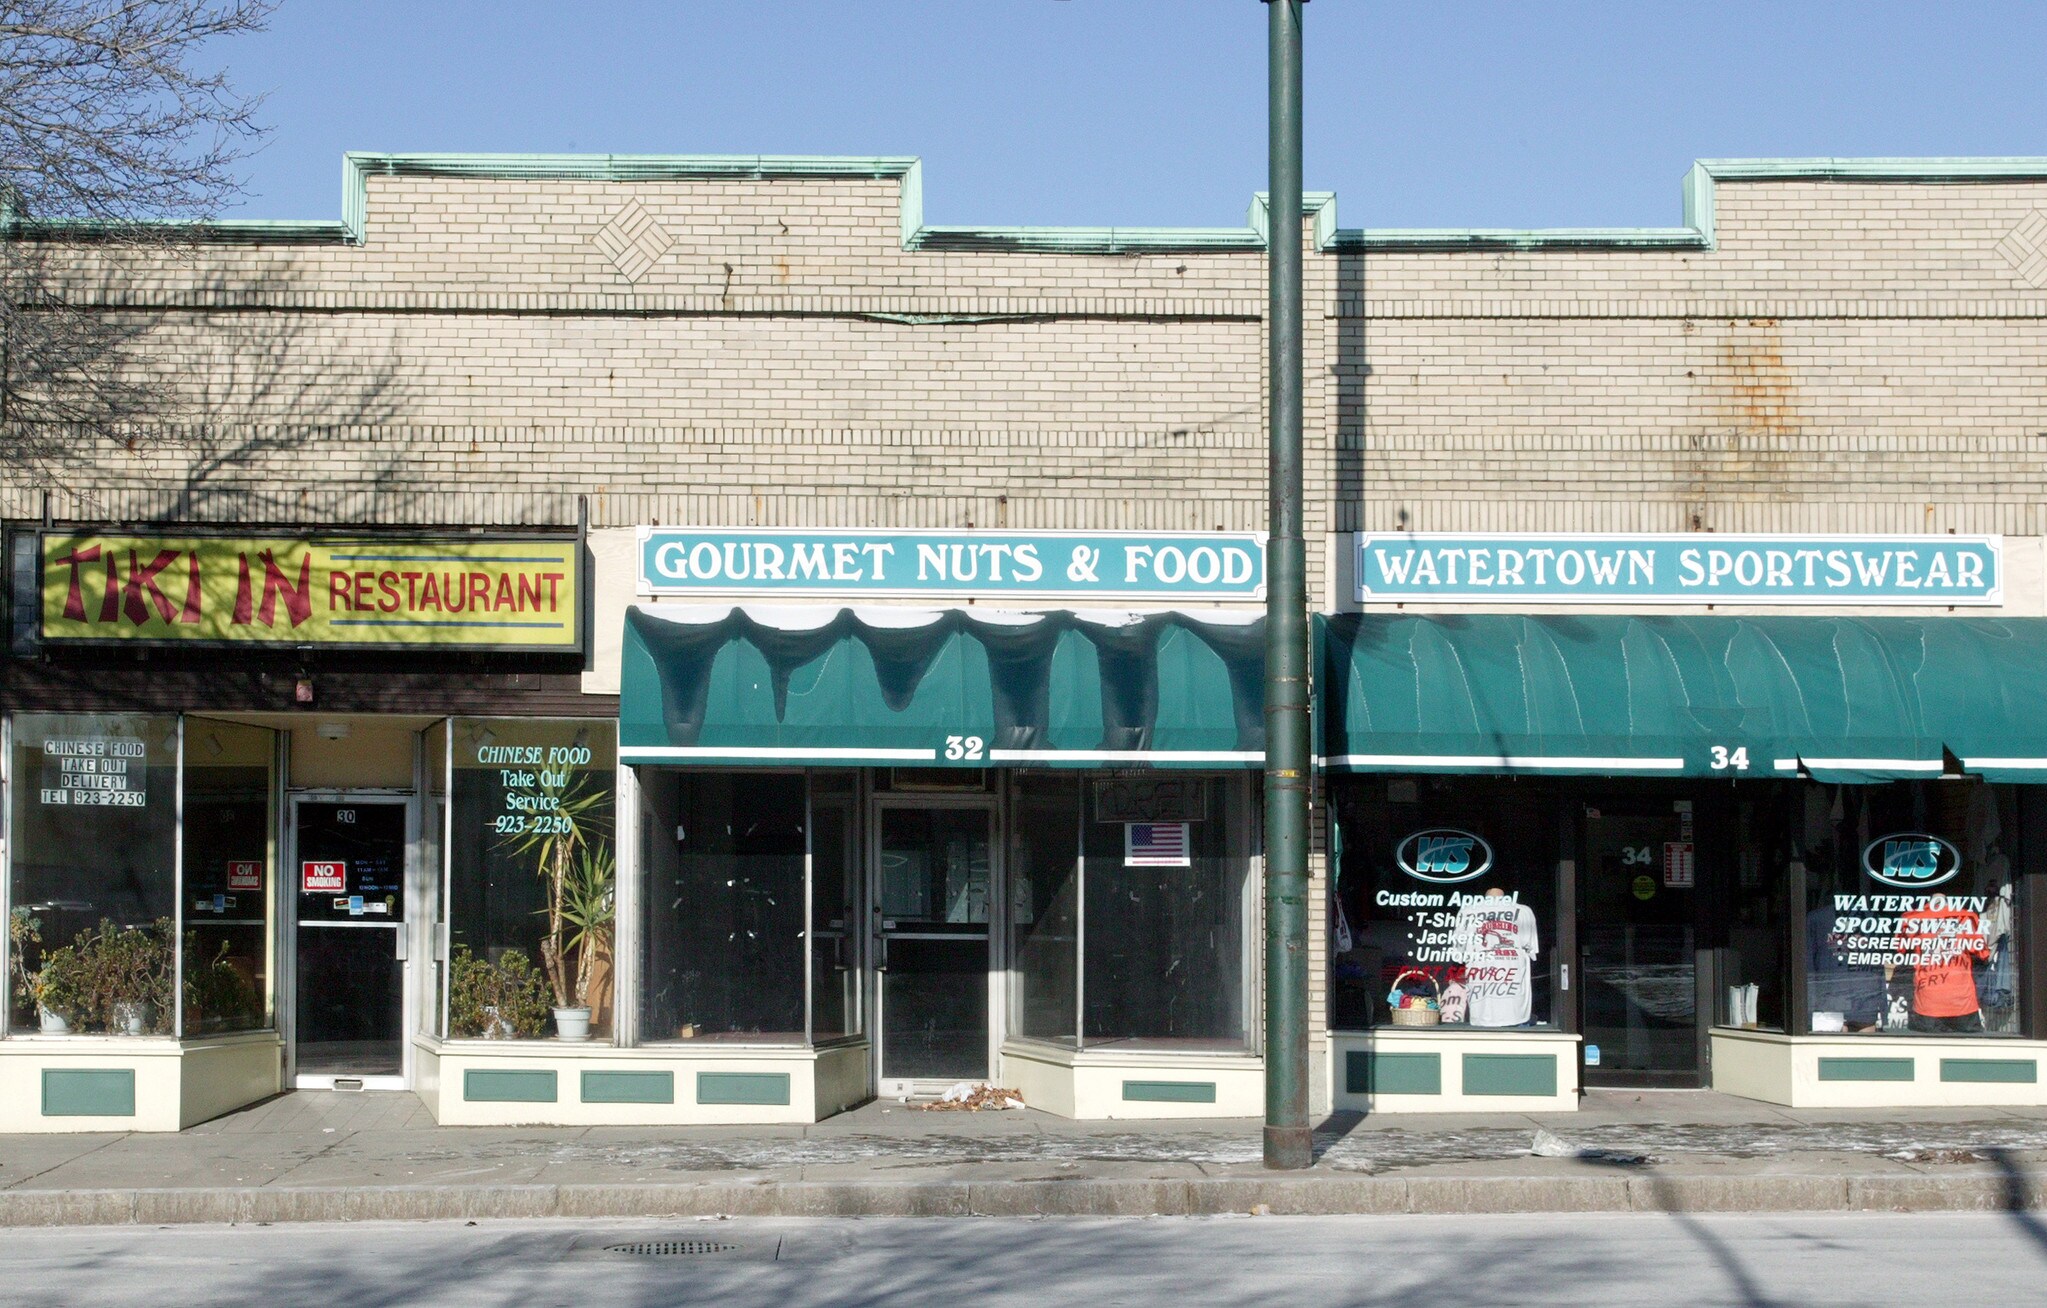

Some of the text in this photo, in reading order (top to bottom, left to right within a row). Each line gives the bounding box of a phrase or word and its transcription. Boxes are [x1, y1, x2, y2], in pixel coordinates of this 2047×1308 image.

[655, 542, 1254, 584] GOURMET NUTS & FOOD
[1375, 548, 1986, 588] WATERTOWN SPORTSWEAR
[55, 543, 312, 628] TIKI IN
[329, 571, 565, 613] RESTAURANT
[45, 741, 144, 756] CHINESE FOOD
[477, 746, 591, 766] CHINESE FOOD
[945, 735, 984, 760] 32
[62, 758, 126, 773] TAKE OUT
[1710, 746, 1750, 770] 34
[62, 775, 126, 789] DELIVERY
[500, 769, 566, 788] Take Out
[42, 790, 145, 805] TEL 923-2250
[505, 792, 560, 811] Service
[337, 809, 355, 823] 30
[495, 815, 573, 834] 923-2250
[1416, 836, 1475, 874] WS
[1622, 846, 1652, 865] 34
[1882, 841, 1941, 878] WS
[314, 865, 334, 877] NO
[306, 876, 342, 888] SMOKING
[1376, 890, 1518, 909] Custom Apparel
[1833, 895, 1987, 911] WATERTOWN
[1833, 918, 1992, 934] SPORTSWEAR
[1416, 930, 1483, 945] Jackets
[1847, 937, 1985, 950] SCREENPRINTING
[1847, 952, 1952, 965] EMBROIDERY
